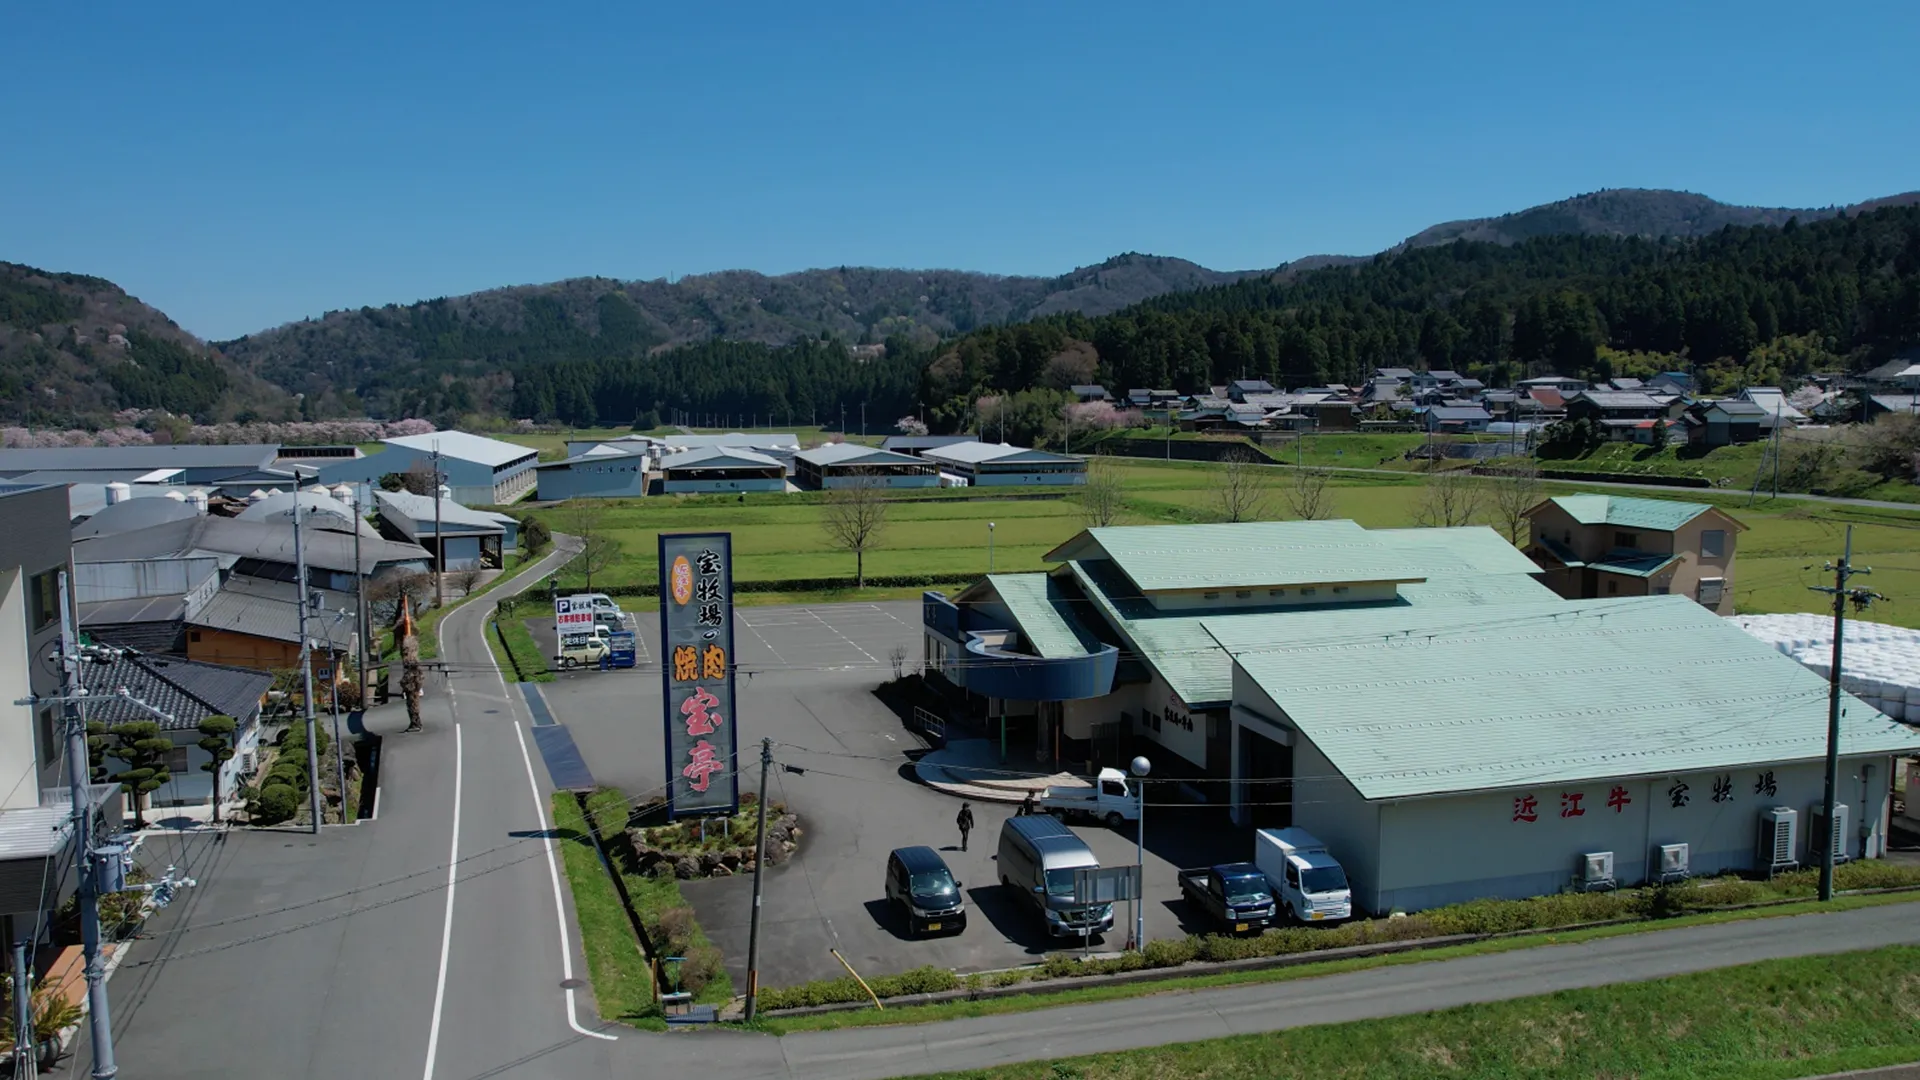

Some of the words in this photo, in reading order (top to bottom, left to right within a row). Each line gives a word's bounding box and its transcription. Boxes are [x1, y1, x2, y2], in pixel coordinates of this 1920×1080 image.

[696, 547, 724, 641] 宝牧場の
[673, 643, 726, 682] 焼肉
[680, 686, 725, 793] 宝亭
[1512, 785, 1632, 823] 近江牛
[1667, 770, 1778, 809] 宝牧場
